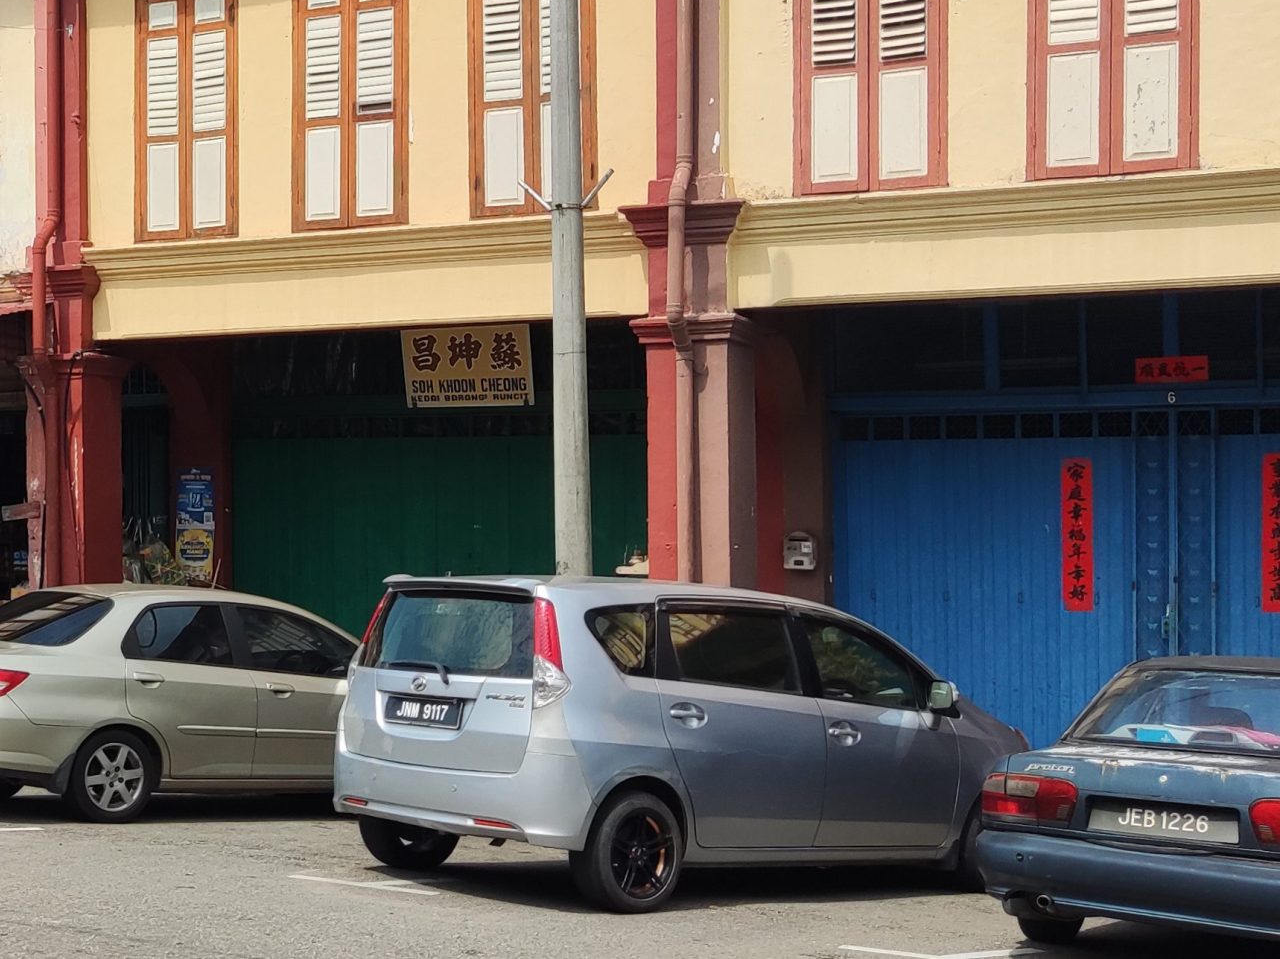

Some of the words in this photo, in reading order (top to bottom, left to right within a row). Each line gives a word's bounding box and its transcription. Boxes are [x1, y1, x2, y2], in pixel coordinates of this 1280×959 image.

[411, 379, 434, 394] SOH
[439, 378, 477, 394] KHOON
[480, 377, 527, 393] CHEONG
[1167, 391, 1176, 404] 6
[396, 701, 421, 719] JNM
[423, 703, 449, 722] 9117
[1024, 762, 1075, 774] proton
[1118, 807, 1156, 828] JEB
[1160, 810, 1210, 833] 1226
